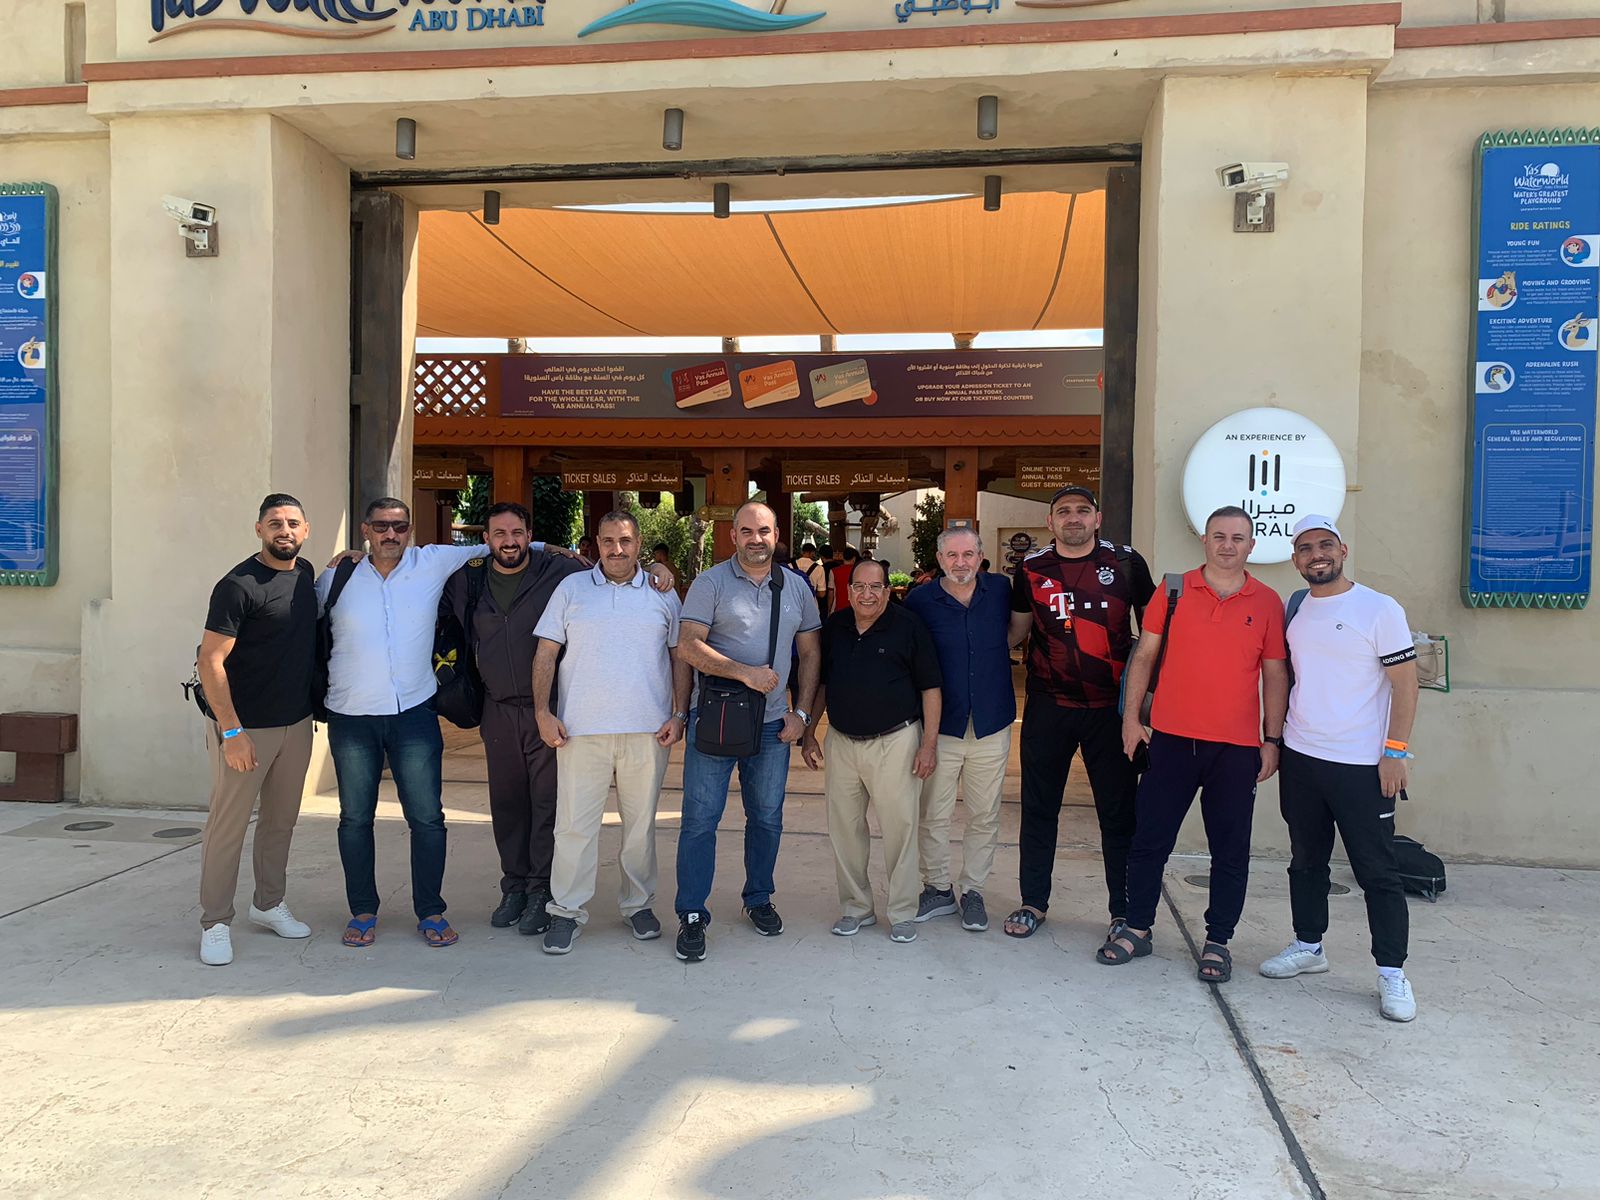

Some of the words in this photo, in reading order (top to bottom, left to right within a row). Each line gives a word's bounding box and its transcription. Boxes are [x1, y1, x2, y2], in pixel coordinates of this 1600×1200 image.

[408, 9, 458, 31] ABU
[466, 6, 544, 31] DHABI
[1524, 164, 1541, 176] Yas
[1510, 222, 1529, 230] RIDE
[1532, 221, 1570, 230] RATINGS
[564, 473, 590, 483] TICKET
[592, 473, 616, 484] SALES
[786, 475, 813, 485] TICKET
[815, 474, 840, 485] SALES
[1255, 522, 1295, 537] RAL
[1383, 654, 1405, 664] ADDING
